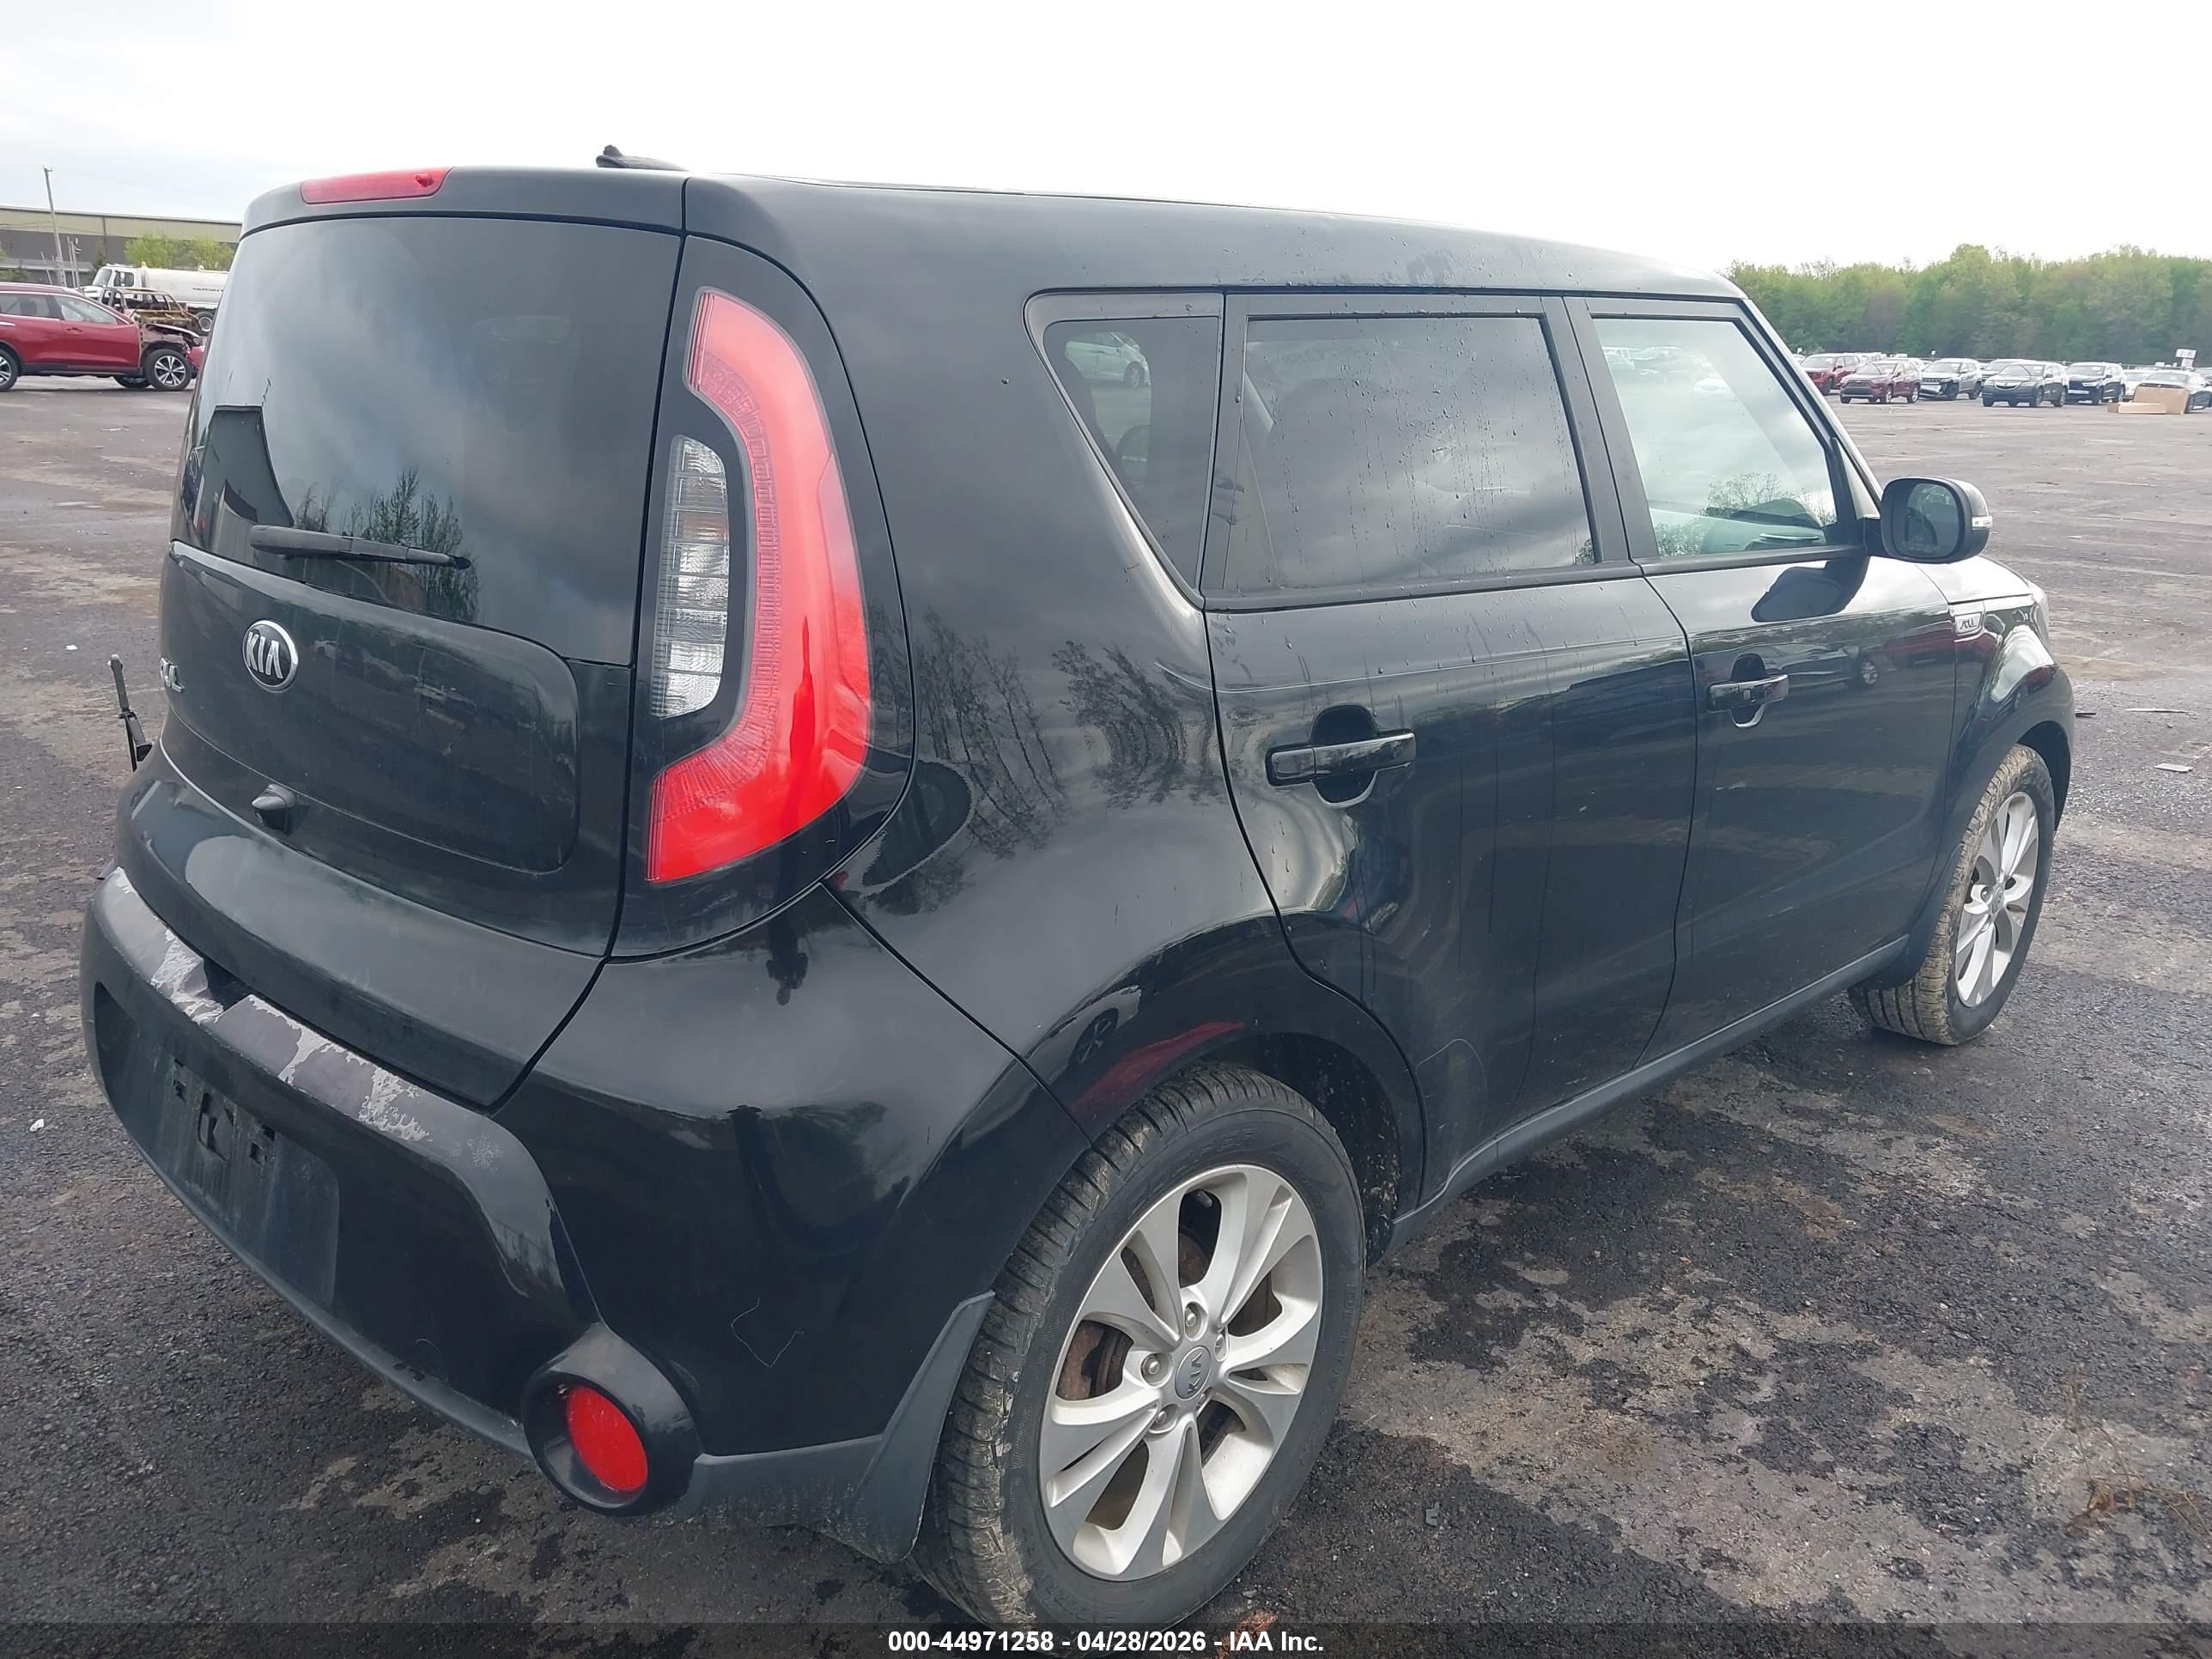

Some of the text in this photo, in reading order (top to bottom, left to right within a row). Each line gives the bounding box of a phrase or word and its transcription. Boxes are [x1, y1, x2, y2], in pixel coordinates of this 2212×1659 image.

[160, 657, 185, 693] OUL
[246, 631, 283, 678] KIA
[1188, 1351, 1203, 1395] KIA
